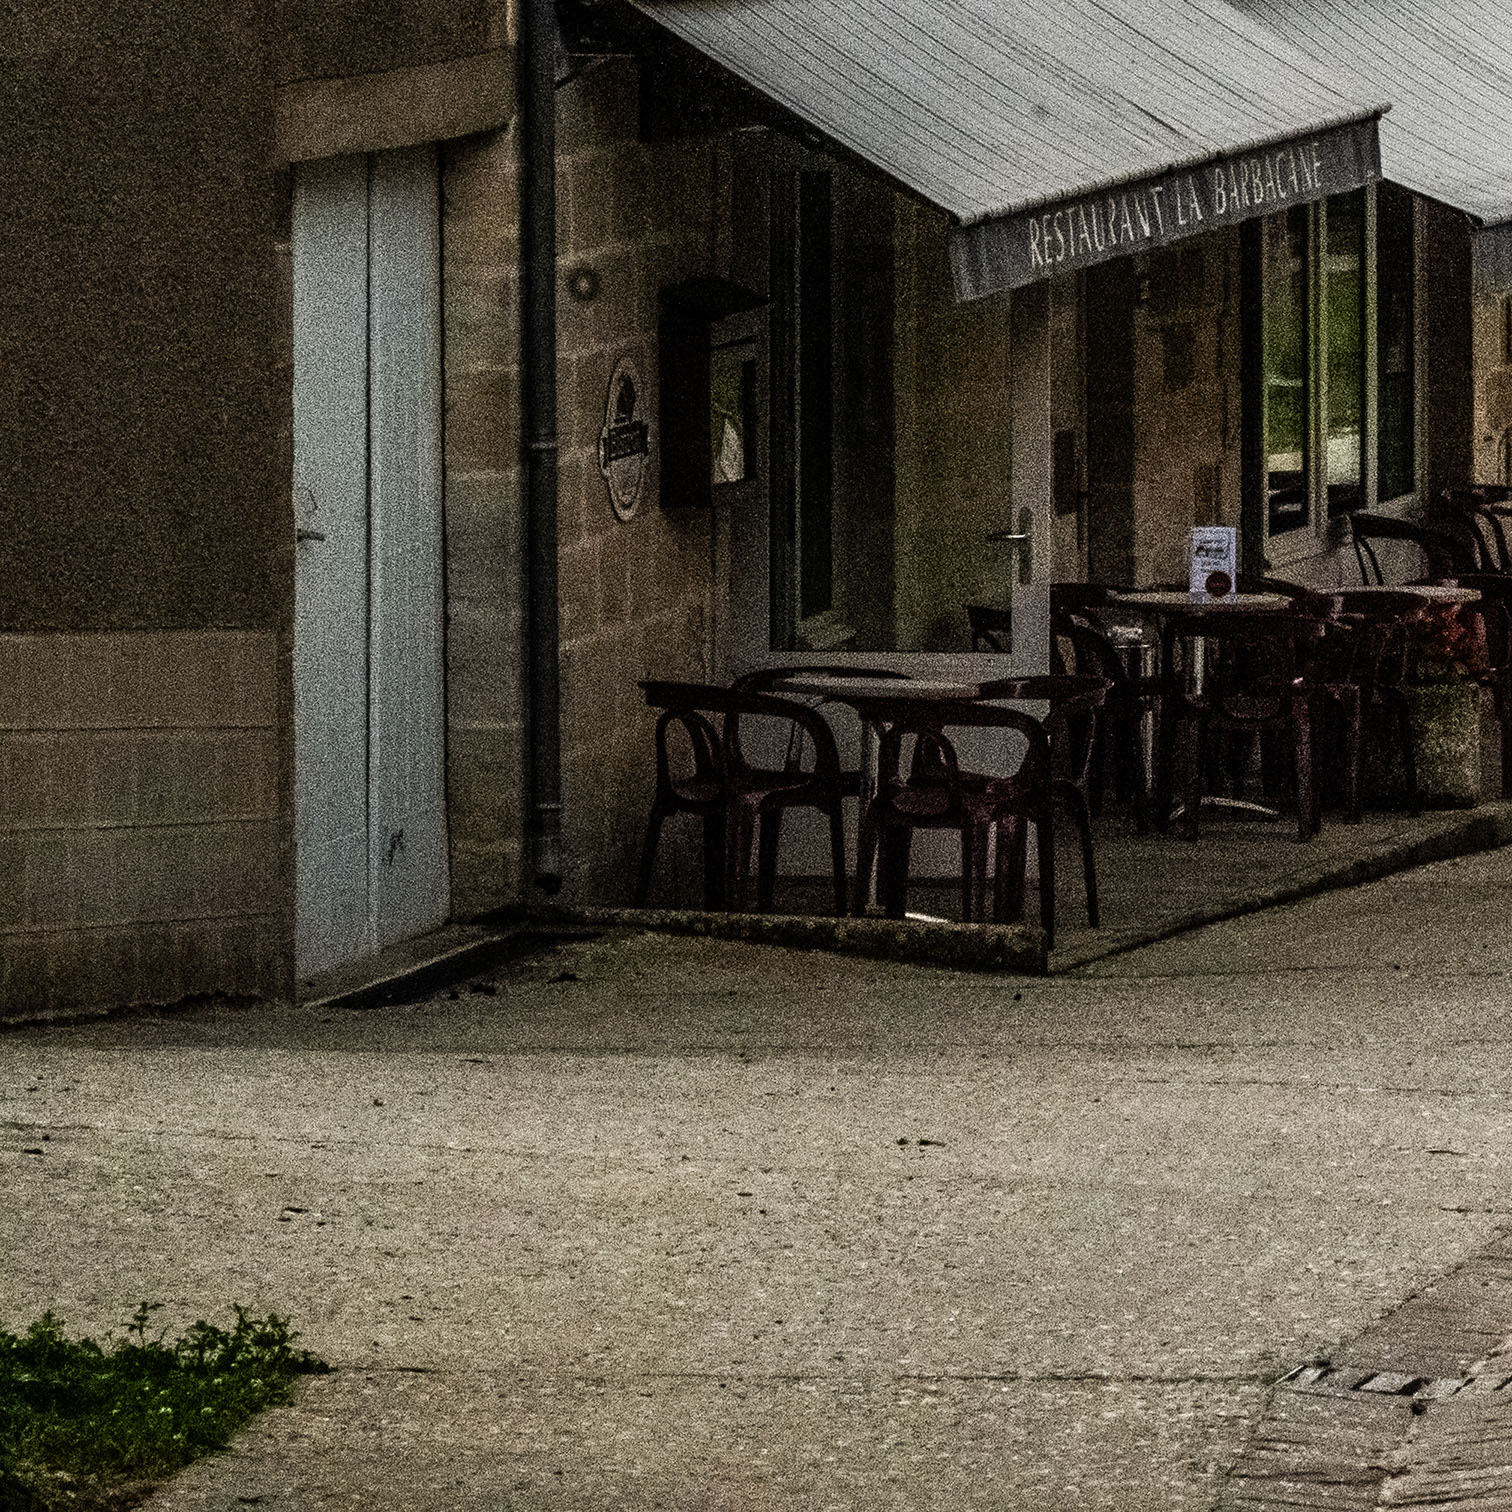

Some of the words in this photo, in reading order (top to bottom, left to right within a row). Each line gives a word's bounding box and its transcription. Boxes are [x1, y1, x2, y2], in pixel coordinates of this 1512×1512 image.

[1028, 186, 1165, 268] RESTAURANT
[1175, 173, 1203, 225] LA
[1213, 142, 1322, 214] BARBACANE
